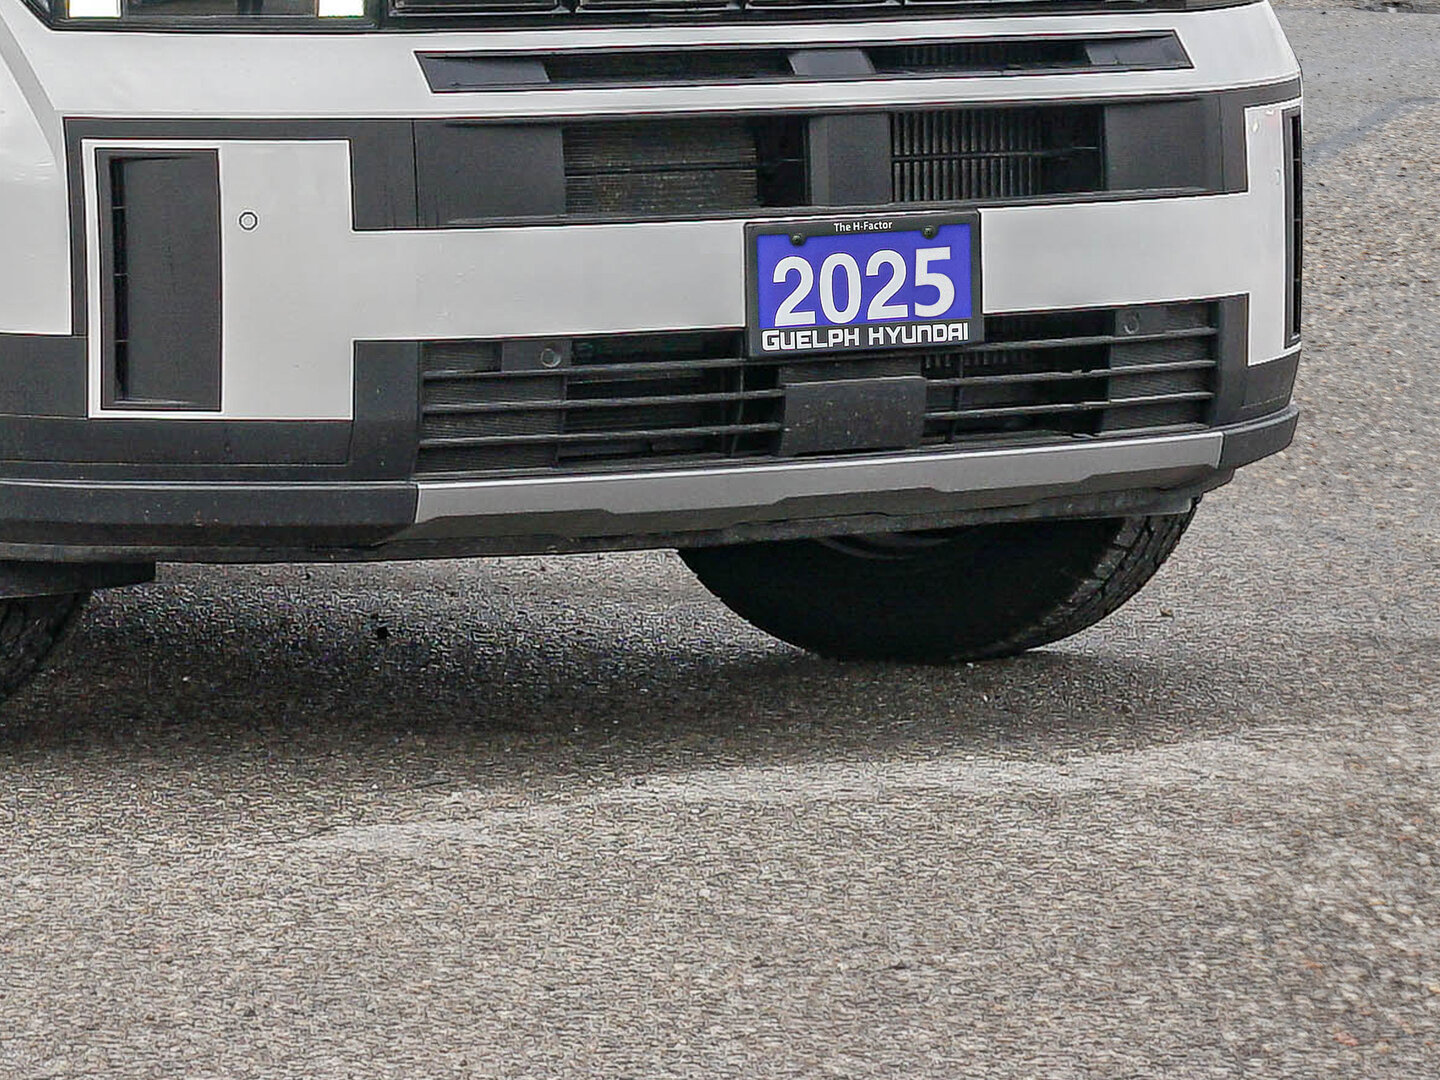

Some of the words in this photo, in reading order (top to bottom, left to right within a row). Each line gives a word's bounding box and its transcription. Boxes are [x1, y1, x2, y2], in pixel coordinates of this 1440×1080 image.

[833, 222, 851, 232] The
[853, 221, 893, 231] H-Factor
[773, 246, 956, 327] 2025
[762, 327, 860, 351] GUELPH
[868, 322, 969, 346] HYUNDAI
